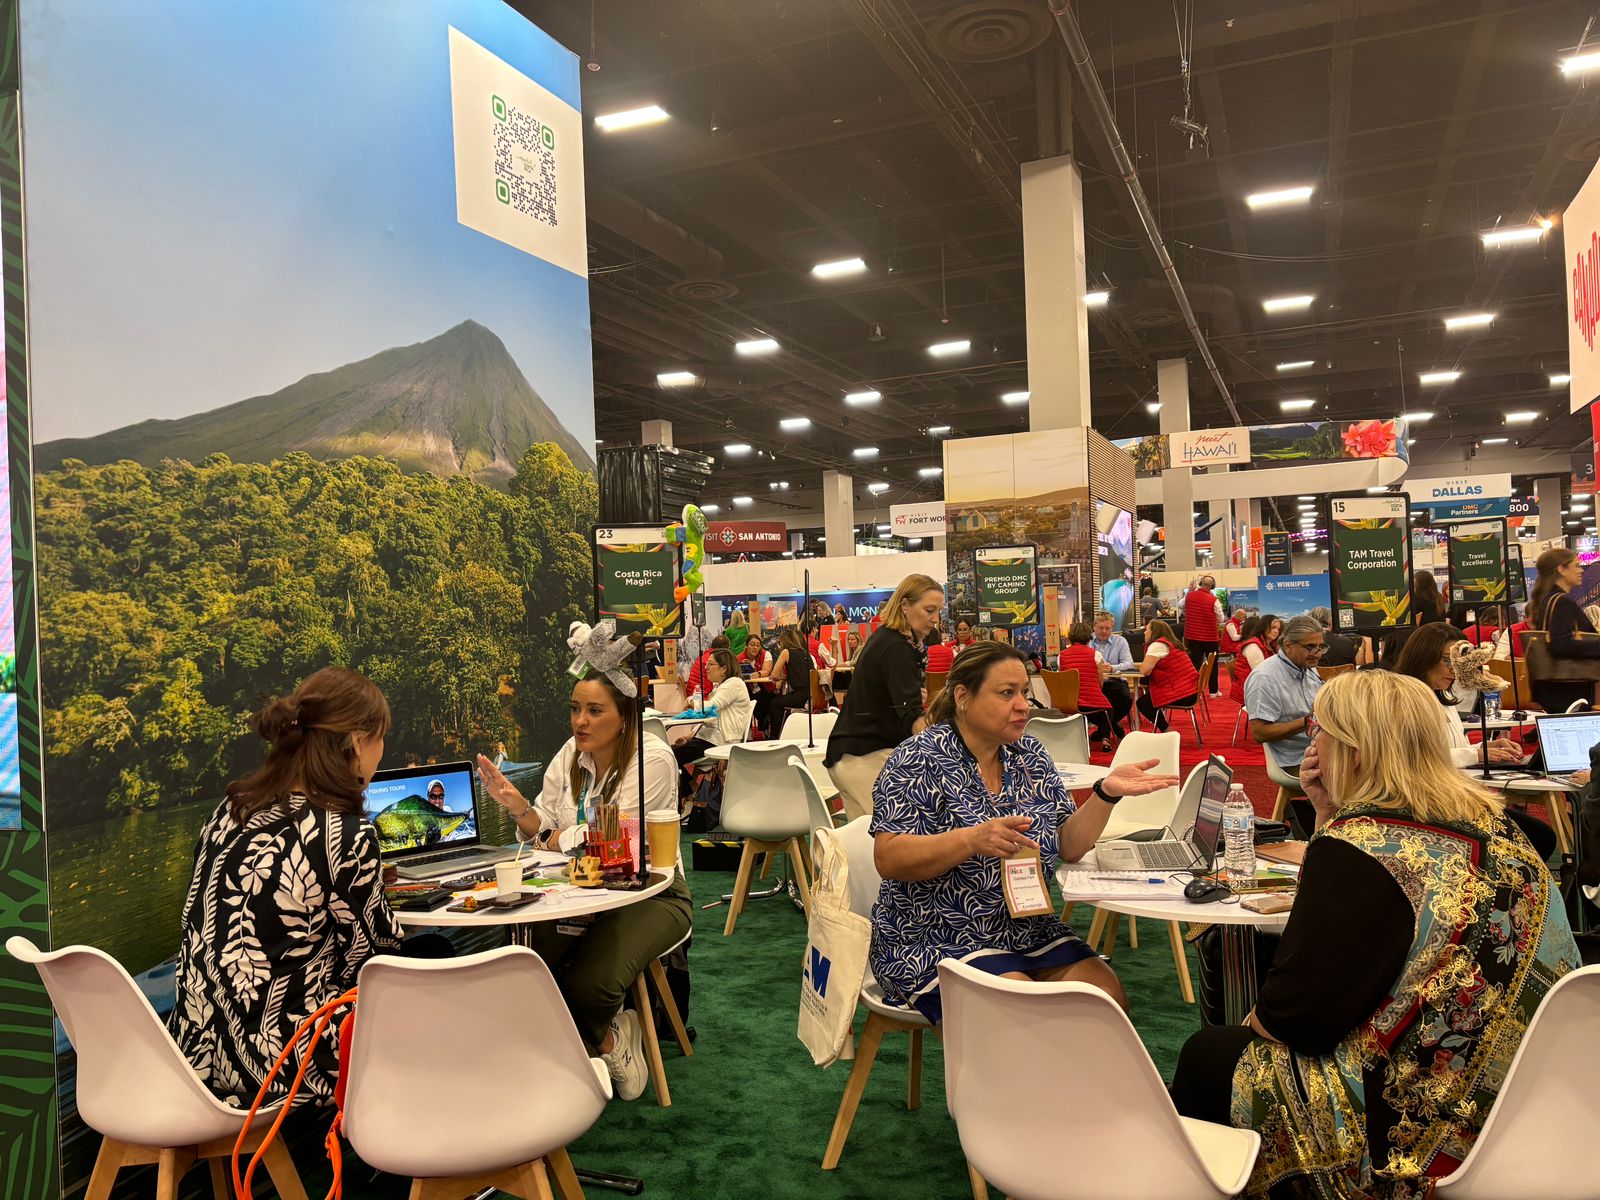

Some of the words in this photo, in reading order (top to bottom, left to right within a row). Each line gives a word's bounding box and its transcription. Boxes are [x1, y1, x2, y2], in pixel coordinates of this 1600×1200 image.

[1573, 231, 1600, 352] CANAD
[1432, 485, 1483, 497] DALLAS
[1333, 502, 1345, 513] 15
[1509, 503, 1530, 512] 800
[909, 516, 929, 524] FORT
[599, 529, 614, 538] 23
[1451, 525, 1460, 533] 17
[704, 532, 718, 540] ISIT
[738, 532, 754, 541] SAN
[755, 532, 782, 541] ANTONIO
[1349, 550, 1368, 559] TAM
[1370, 548, 1395, 558] Travel
[1468, 552, 1487, 560] Travel
[1347, 559, 1397, 570] Corporation
[1461, 559, 1494, 567] Excellence
[614, 570, 641, 578] Costa
[625, 578, 652, 587] Magic
[984, 575, 1011, 583] PREMIO
[1277, 580, 1310, 588] WINNIPEG
